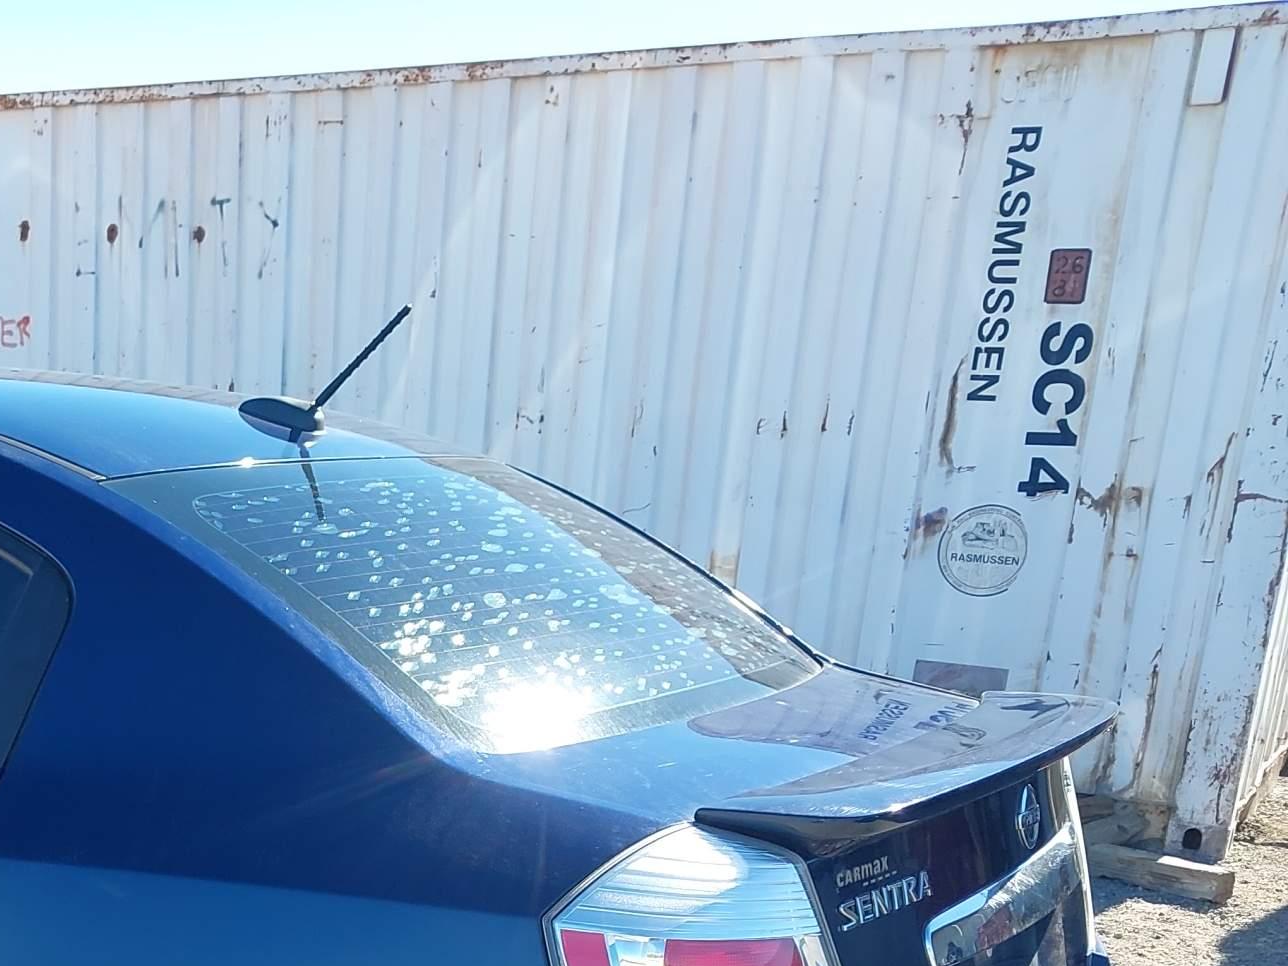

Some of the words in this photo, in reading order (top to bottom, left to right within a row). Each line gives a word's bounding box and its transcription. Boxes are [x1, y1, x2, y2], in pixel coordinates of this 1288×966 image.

[967, 126, 1043, 402] RASMUSSEN
[1017, 321, 1095, 498] SC14
[950, 552, 1020, 567] RASMUSSEN
[839, 871, 933, 931] SENTRA
